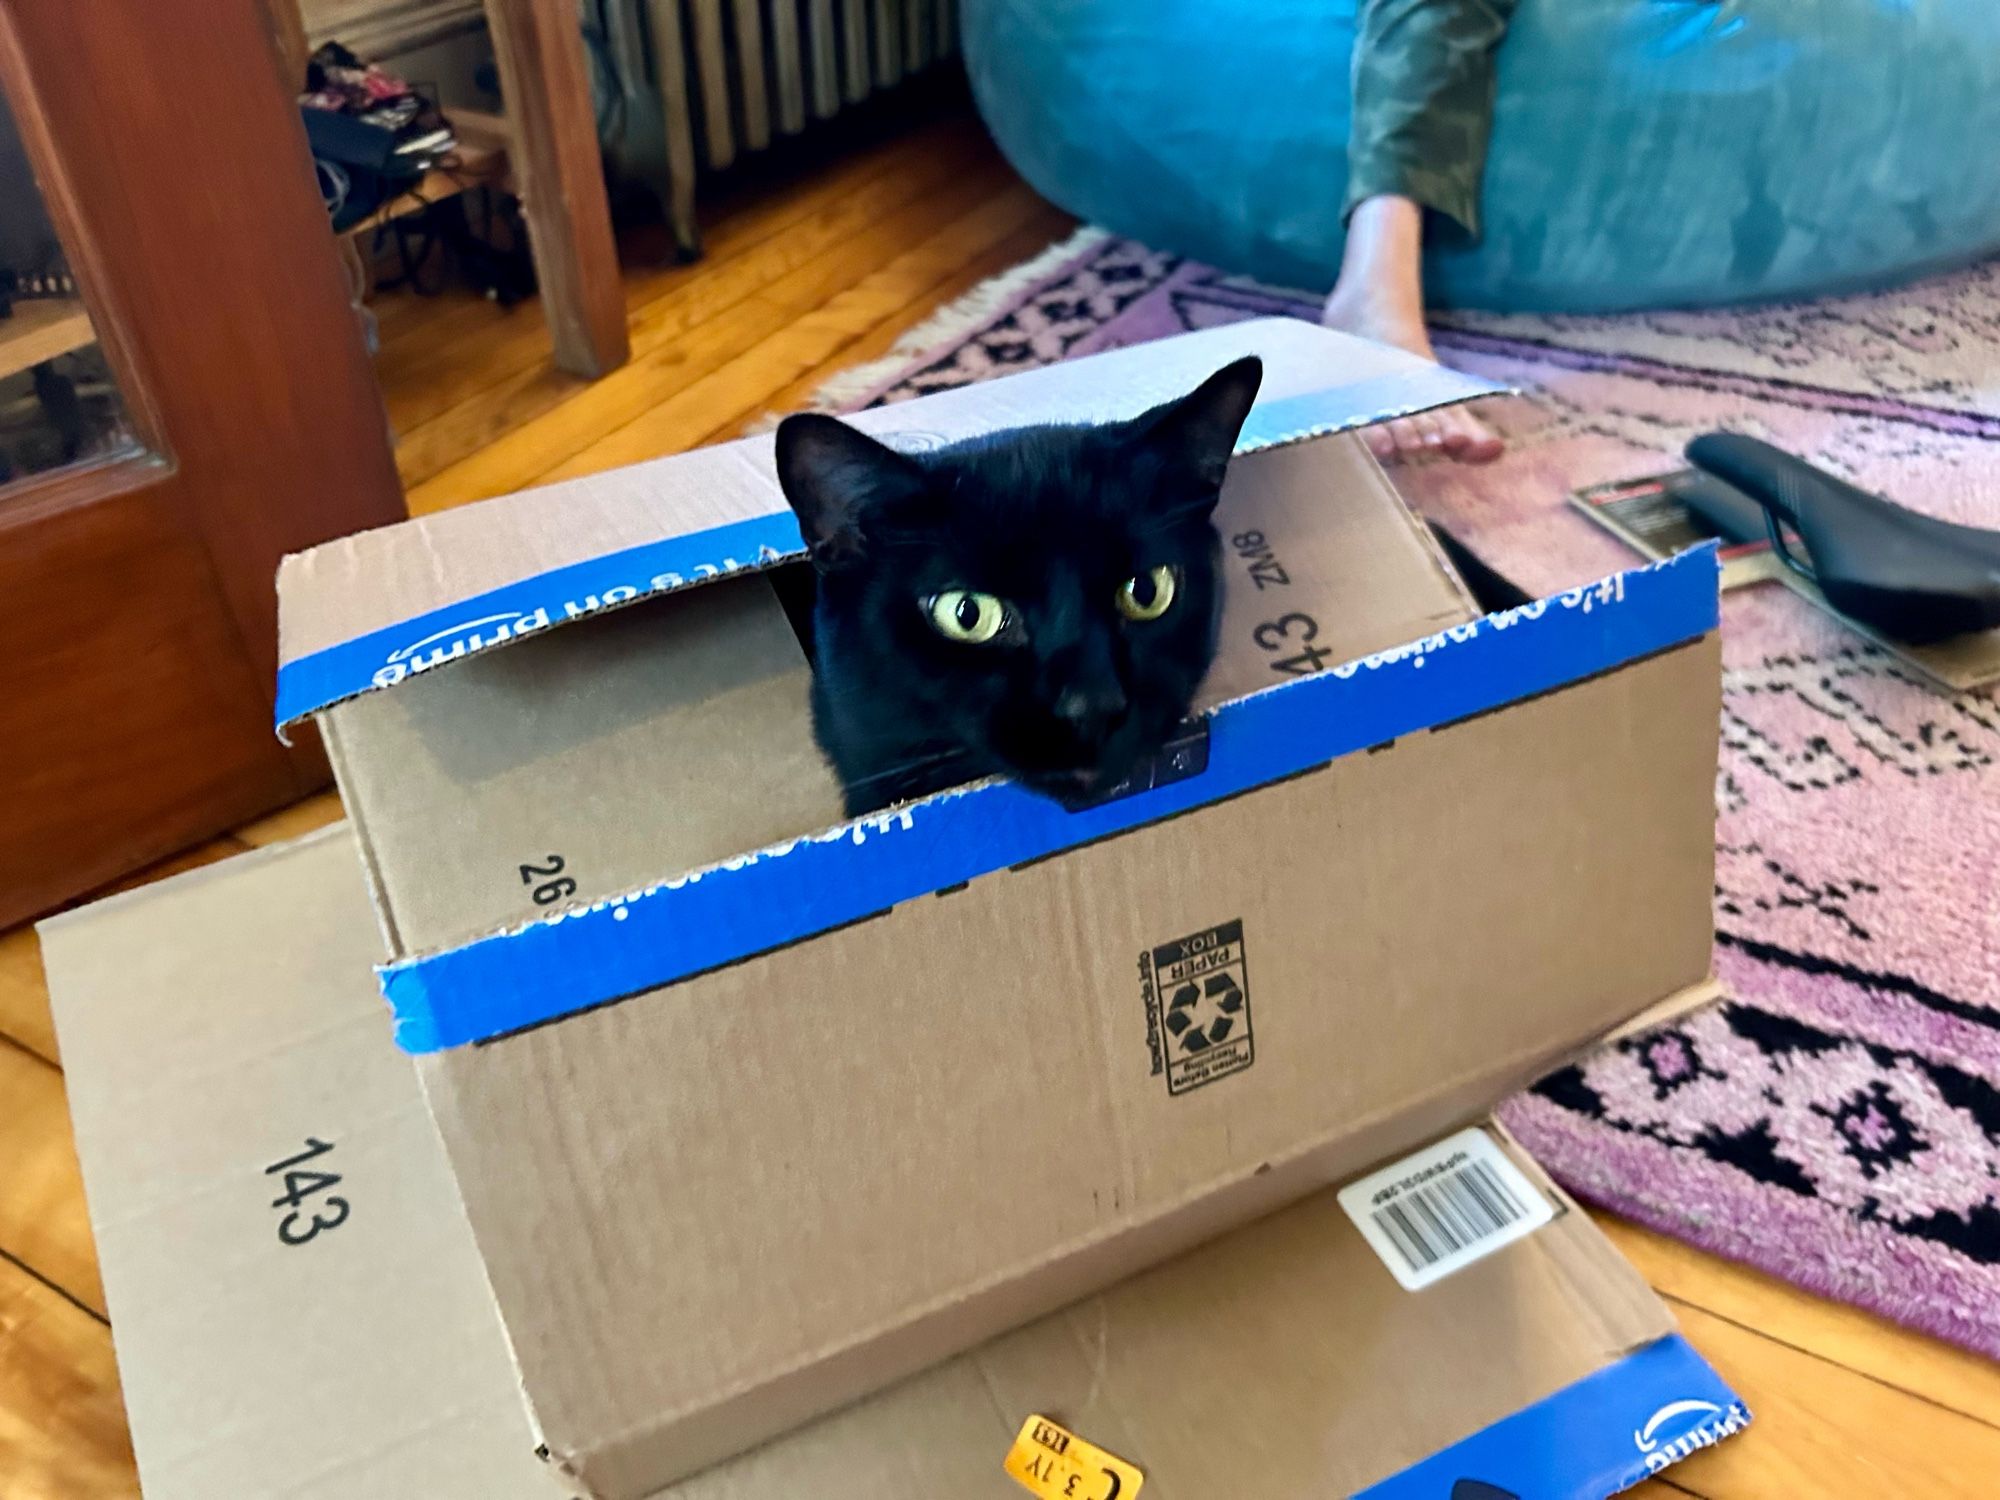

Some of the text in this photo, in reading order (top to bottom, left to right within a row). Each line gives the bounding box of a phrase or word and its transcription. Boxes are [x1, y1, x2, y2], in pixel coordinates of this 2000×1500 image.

[1232, 530, 1291, 591] ZM8
[1171, 947, 1230, 980] PAPER
[1180, 932, 1218, 958] BOX
[265, 1137, 350, 1244] 143
